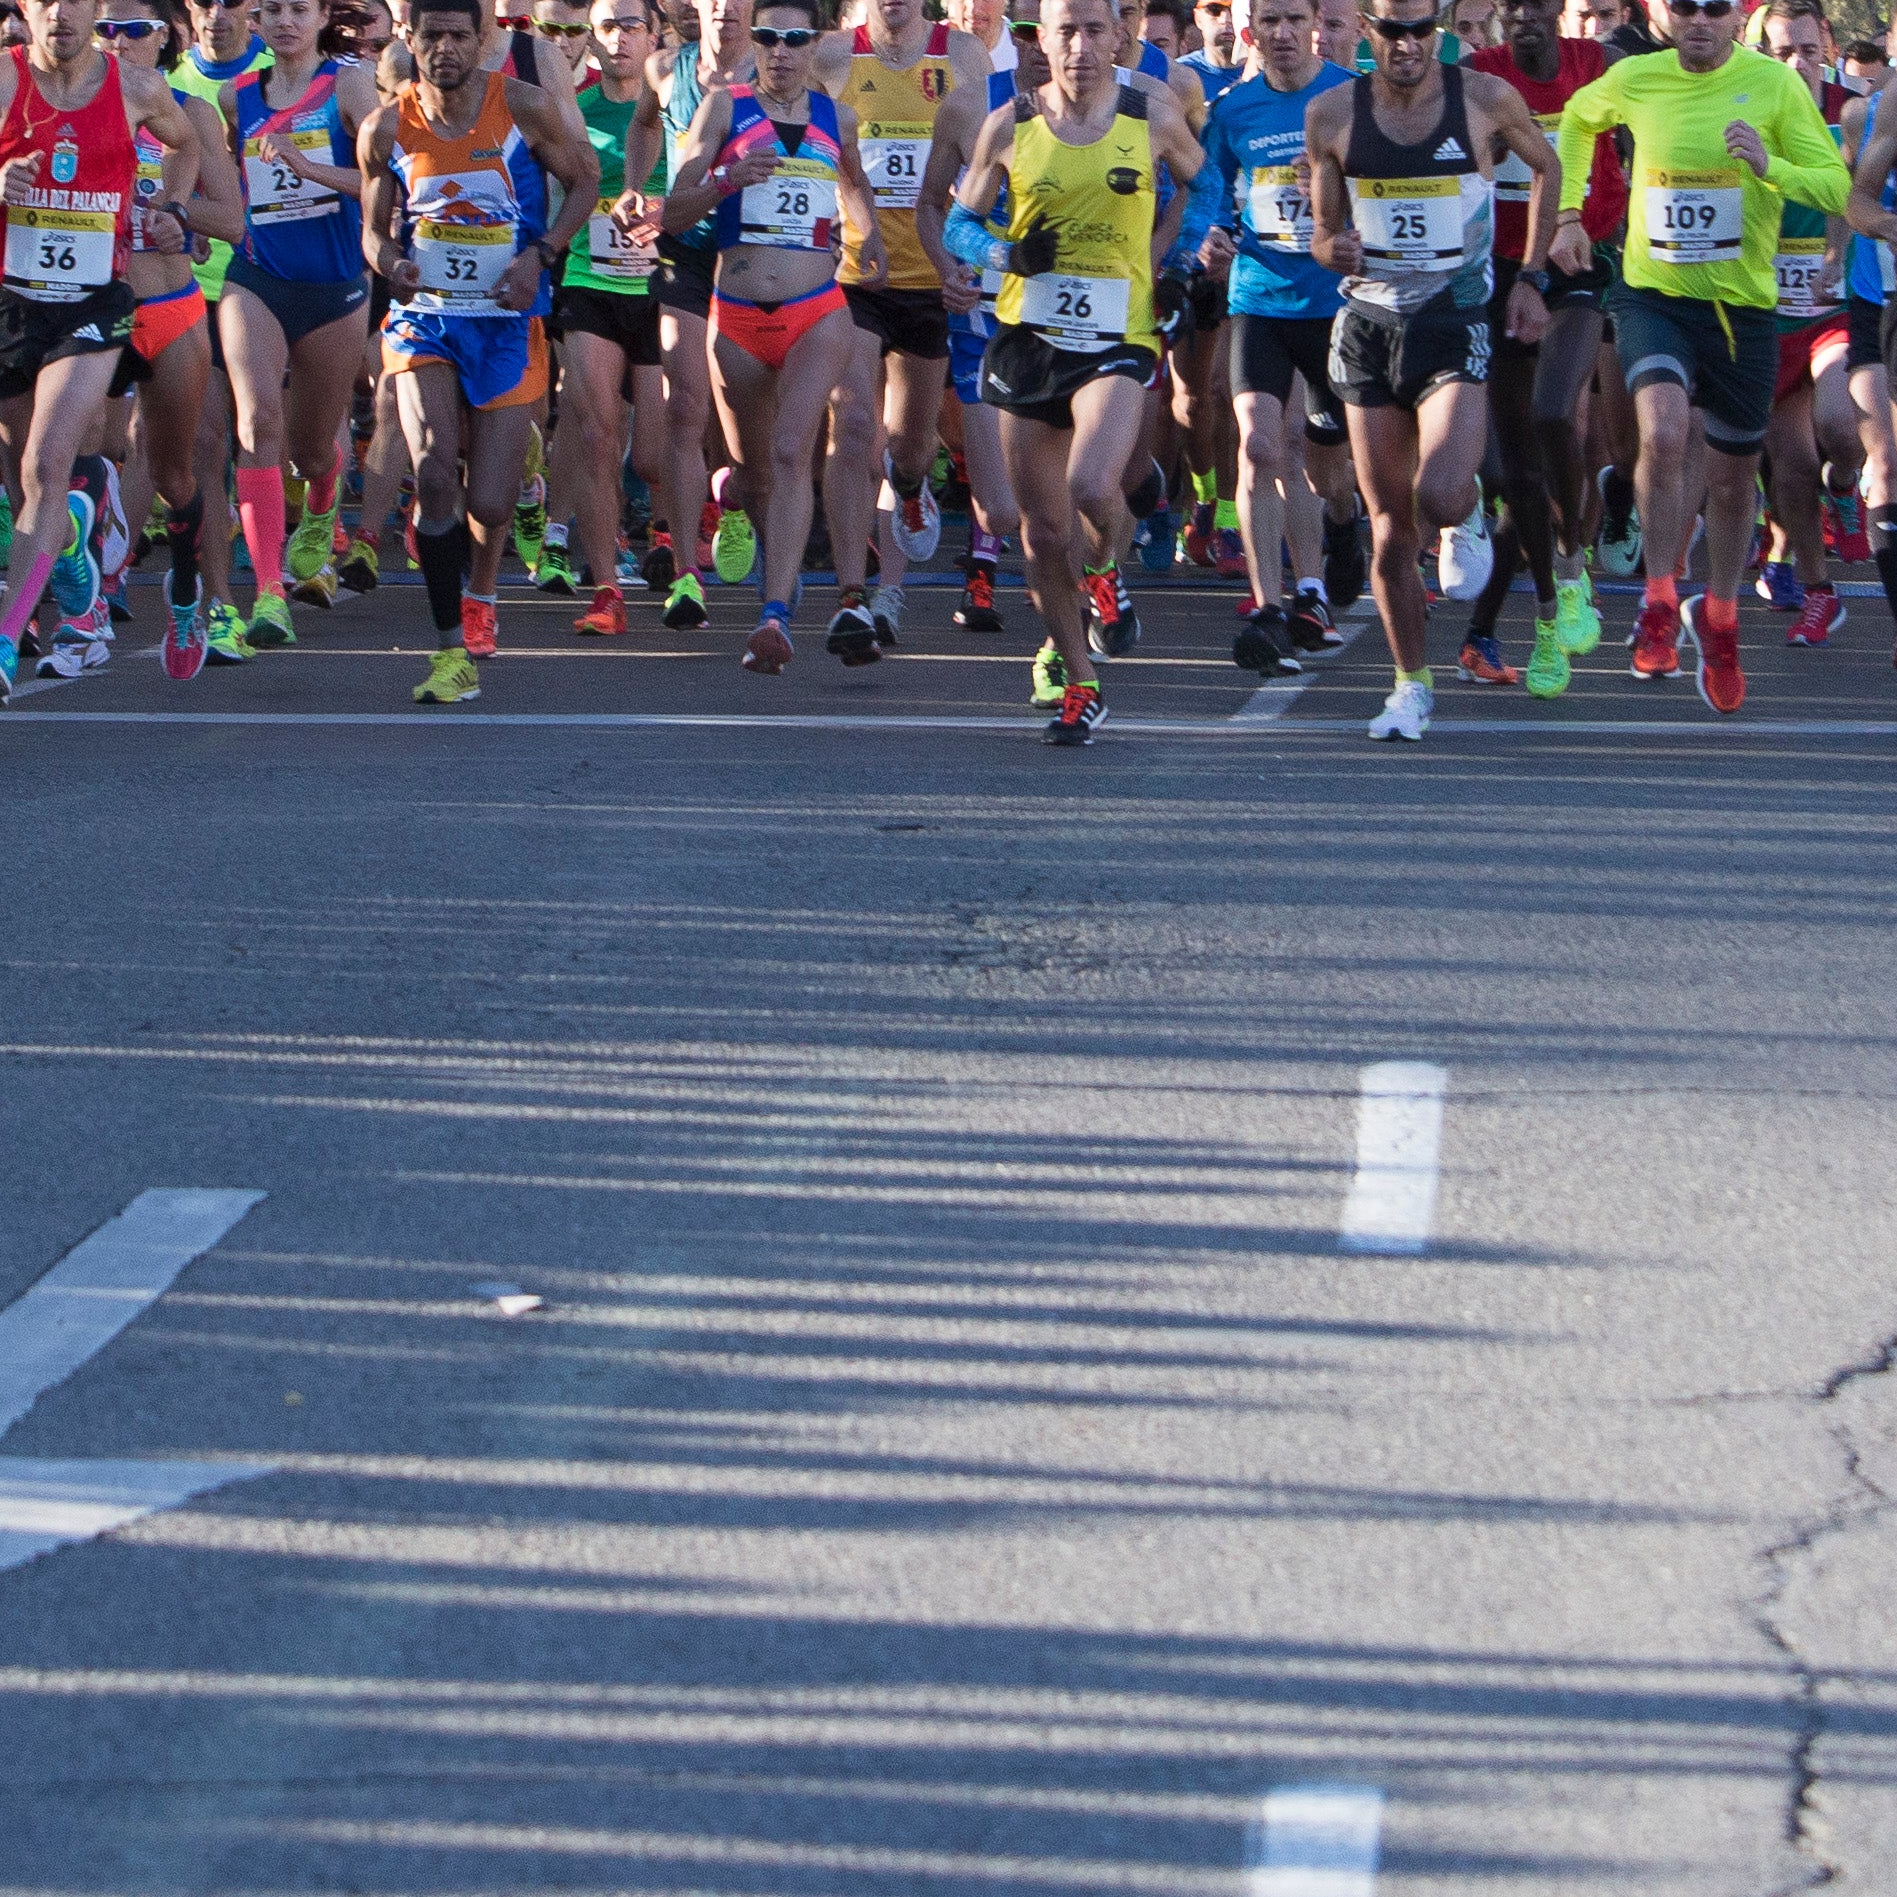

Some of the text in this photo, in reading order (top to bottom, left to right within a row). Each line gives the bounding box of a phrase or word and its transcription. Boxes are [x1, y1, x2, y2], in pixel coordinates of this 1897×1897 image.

[887, 155, 916, 177] 81
[272, 169, 302, 192] 23
[776, 192, 809, 215] 28
[42, 216, 96, 227] RENAULT
[1392, 215, 1426, 239] 25
[1665, 205, 1716, 229] 109
[39, 246, 77, 270] 36
[445, 258, 478, 281] 32
[1056, 292, 1091, 318] 26
